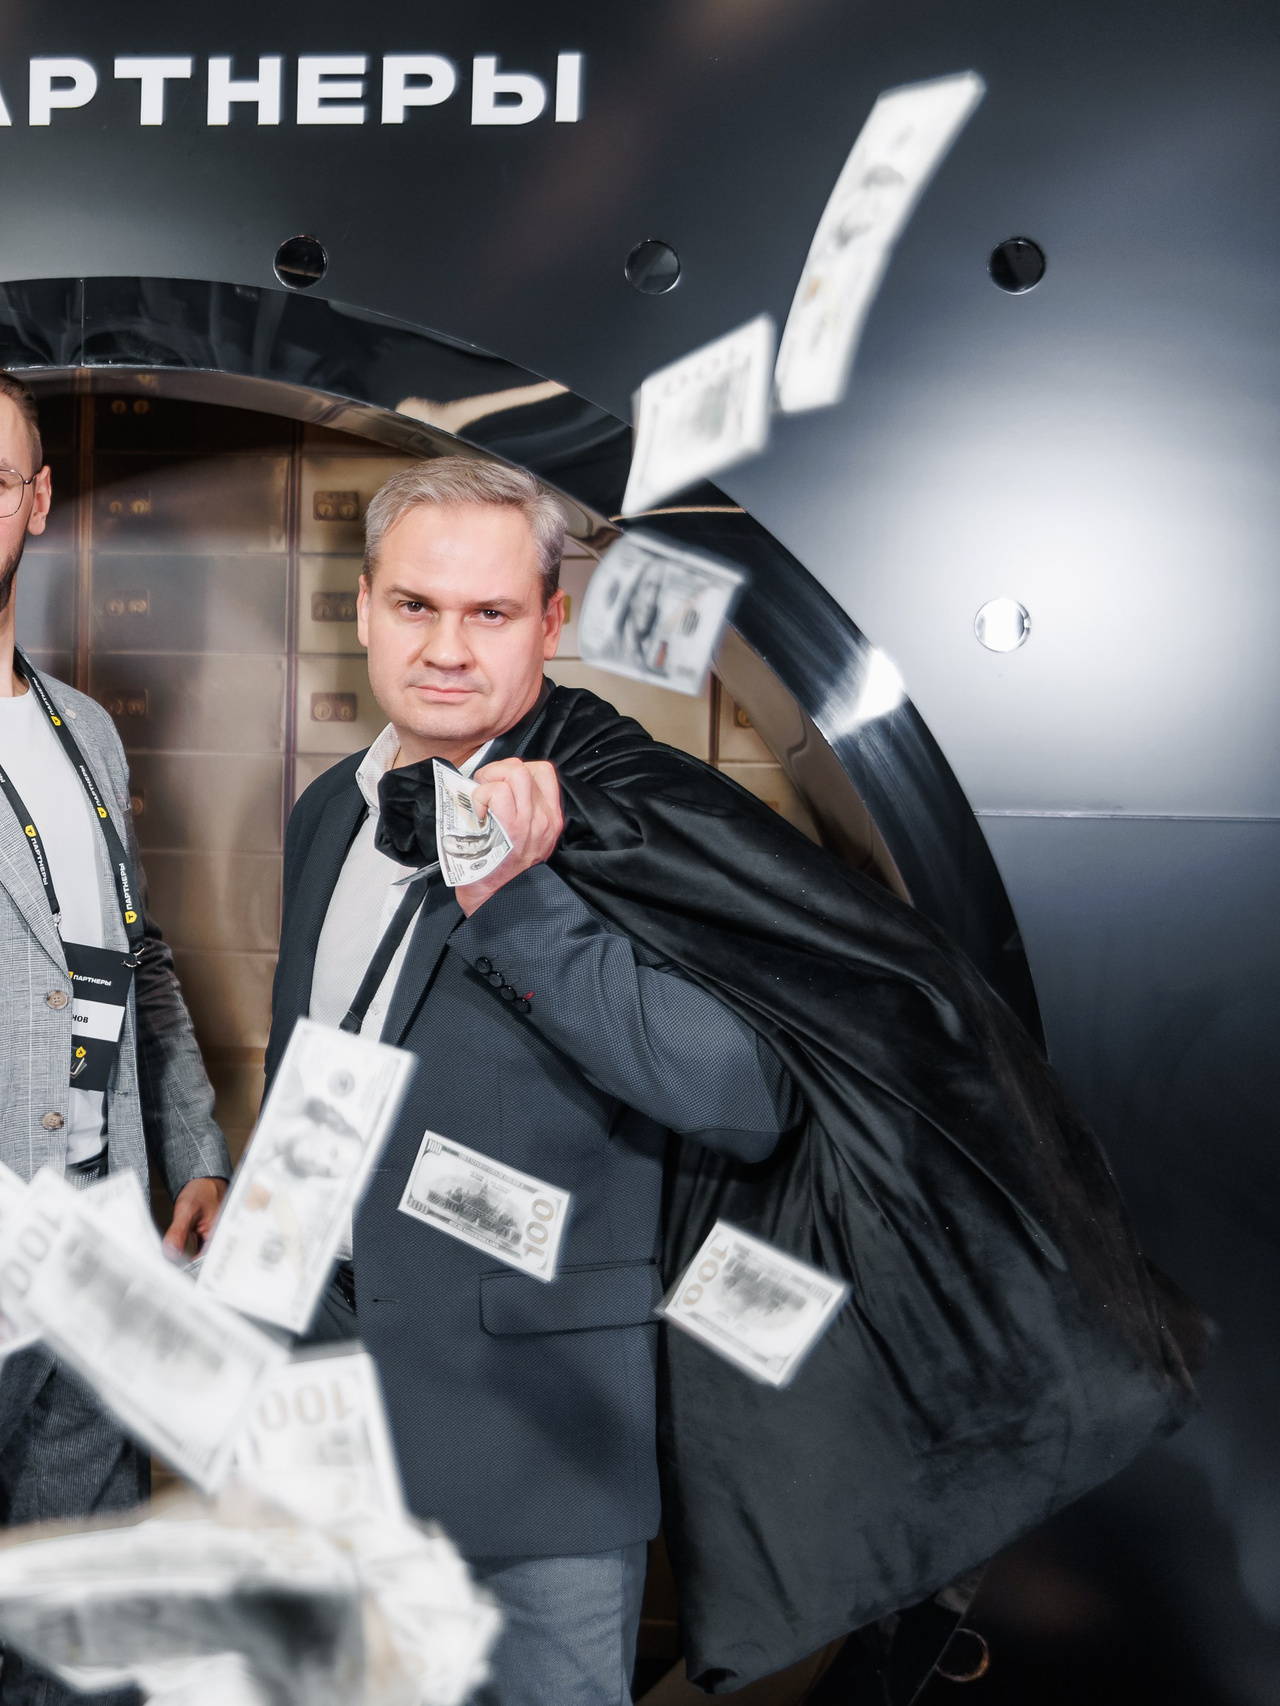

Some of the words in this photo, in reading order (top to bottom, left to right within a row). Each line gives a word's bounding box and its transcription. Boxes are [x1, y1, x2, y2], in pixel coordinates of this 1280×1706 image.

[79, 765, 102, 806] ПАРТНЕРЫ
[31, 838, 48, 886] ПАРТНЕРЫ
[119, 863, 133, 910] ПАРТНЕРЫ
[73, 974, 112, 987] ПАРТНЕРЫ
[523, 1198, 555, 1257] 100
[682, 1244, 730, 1306] 100
